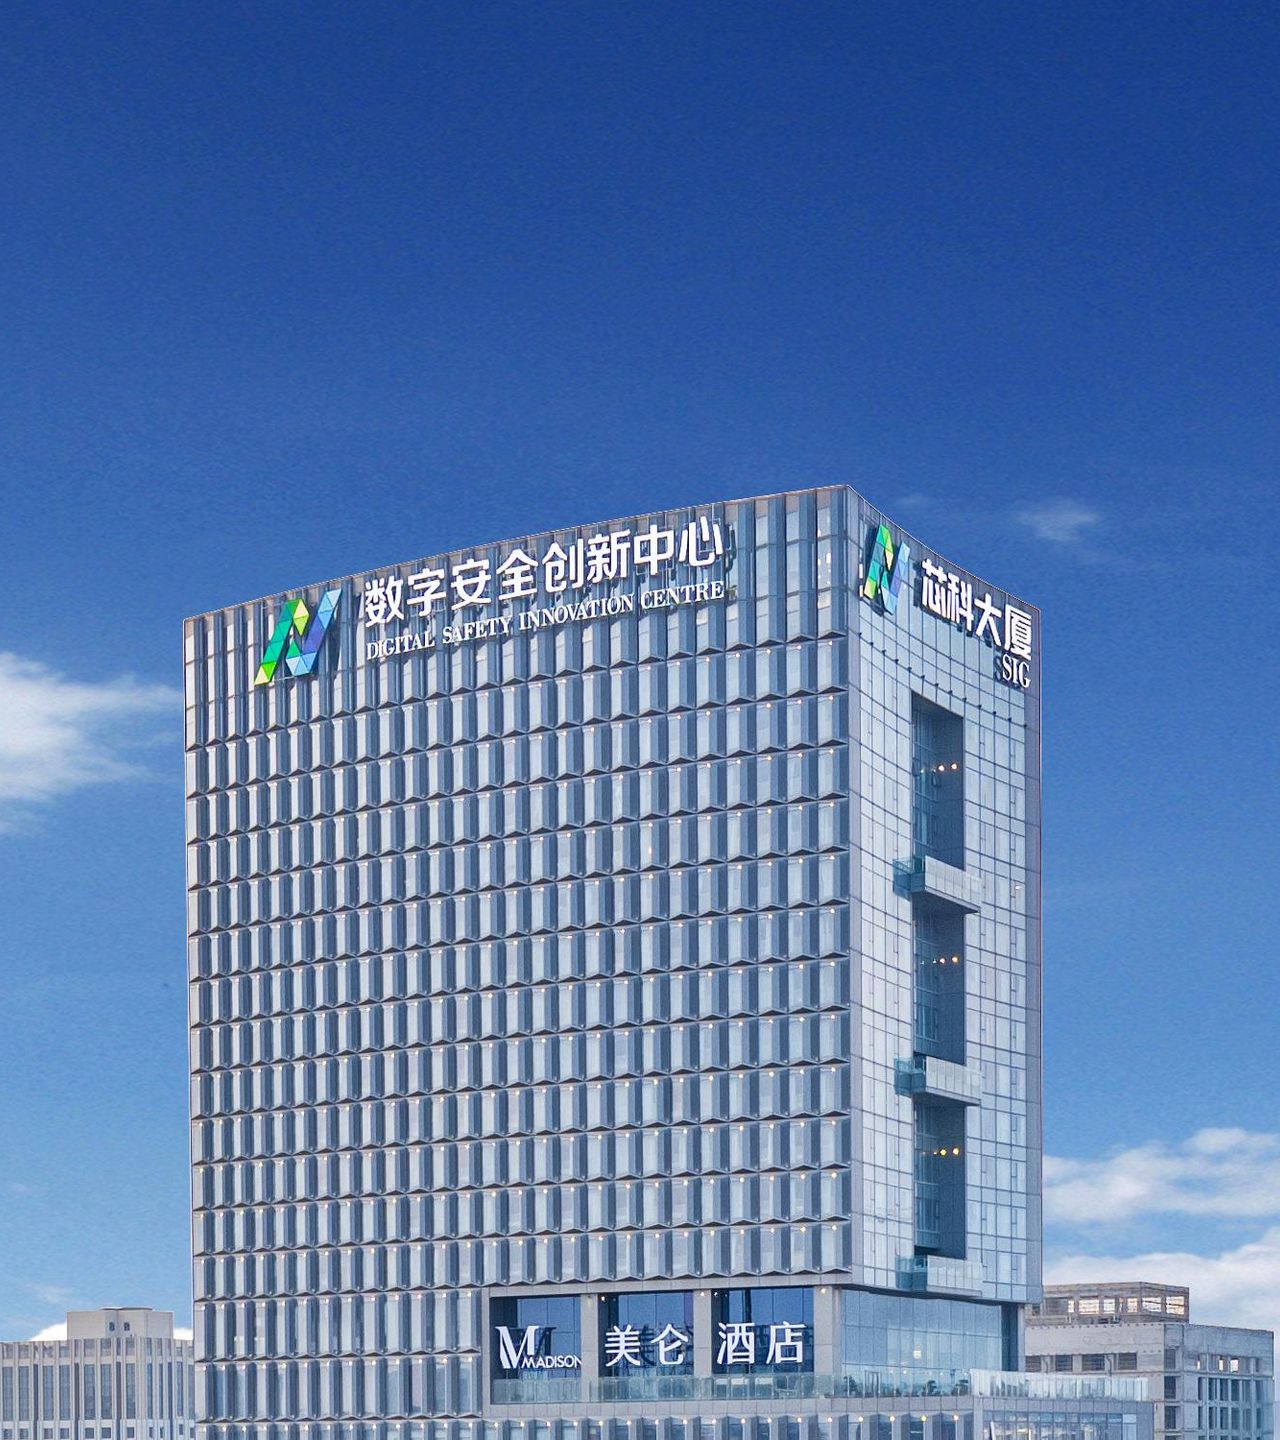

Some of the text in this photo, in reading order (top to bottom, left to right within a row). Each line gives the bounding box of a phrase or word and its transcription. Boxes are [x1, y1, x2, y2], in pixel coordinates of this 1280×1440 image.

[364, 516, 726, 628] 数字安全创新中心
[921, 558, 1032, 661] 芯科大厦
[366, 580, 725, 660] DIGITAL SAFETY INNOVATION CENTRE
[1002, 653, 1032, 689] SIG
